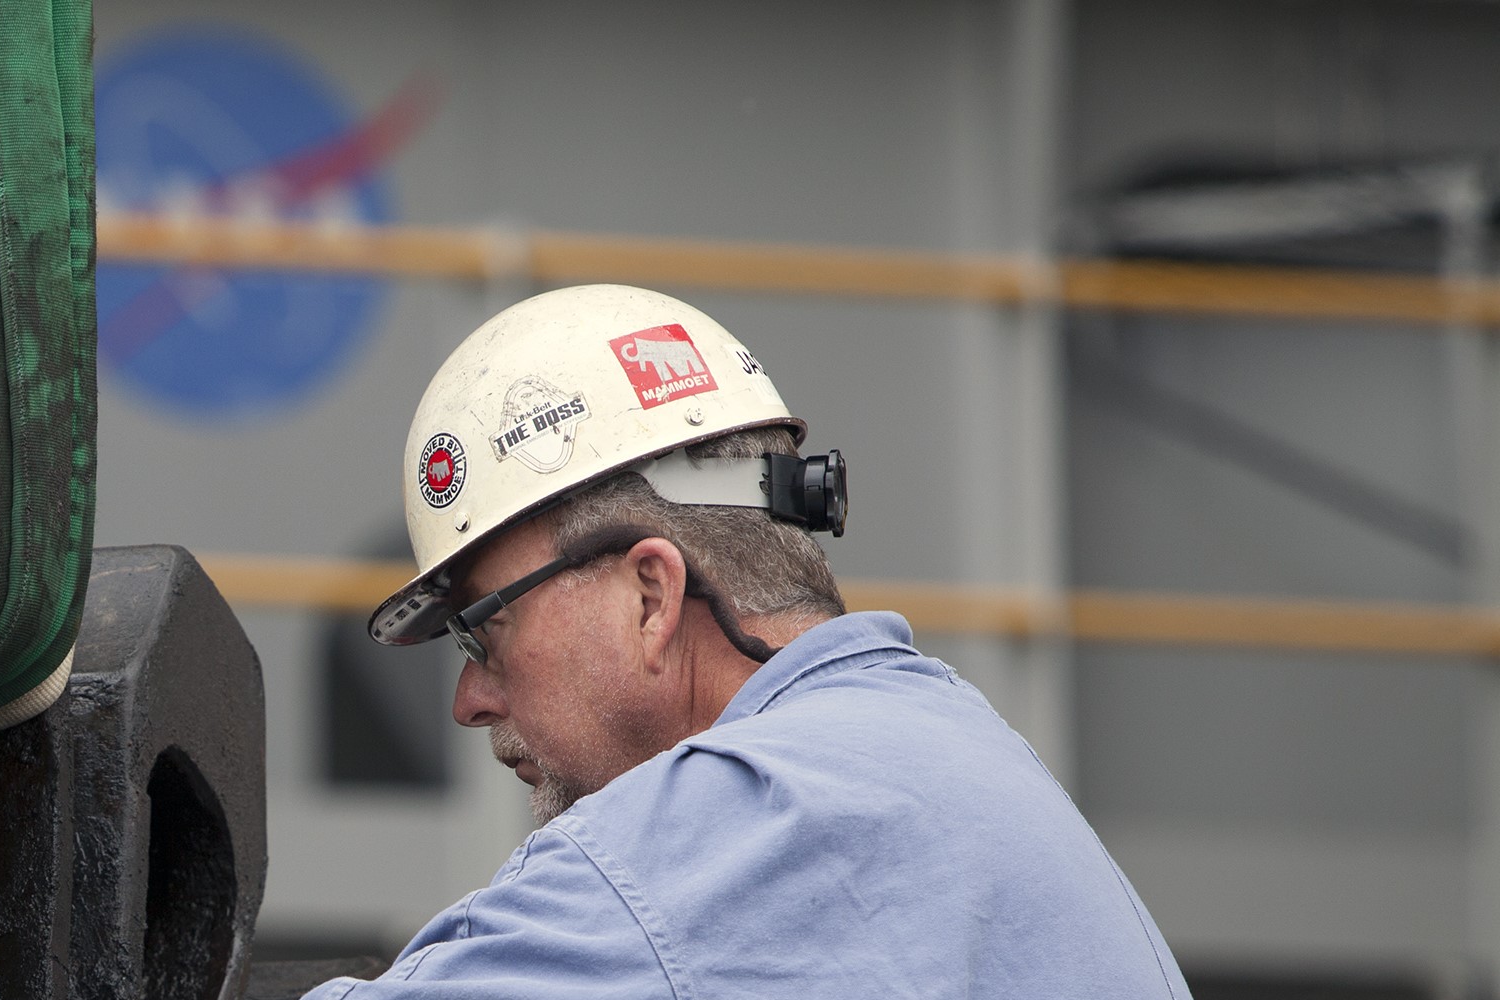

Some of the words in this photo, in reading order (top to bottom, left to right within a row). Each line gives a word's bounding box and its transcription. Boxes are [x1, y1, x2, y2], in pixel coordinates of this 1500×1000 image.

[642, 374, 710, 402] MAMMOET
[494, 423, 530, 456] THE
[532, 398, 585, 432] BOSS
[420, 437, 445, 474] MOVED
[447, 440, 460, 453] BY
[425, 466, 463, 504] MAMMOET
